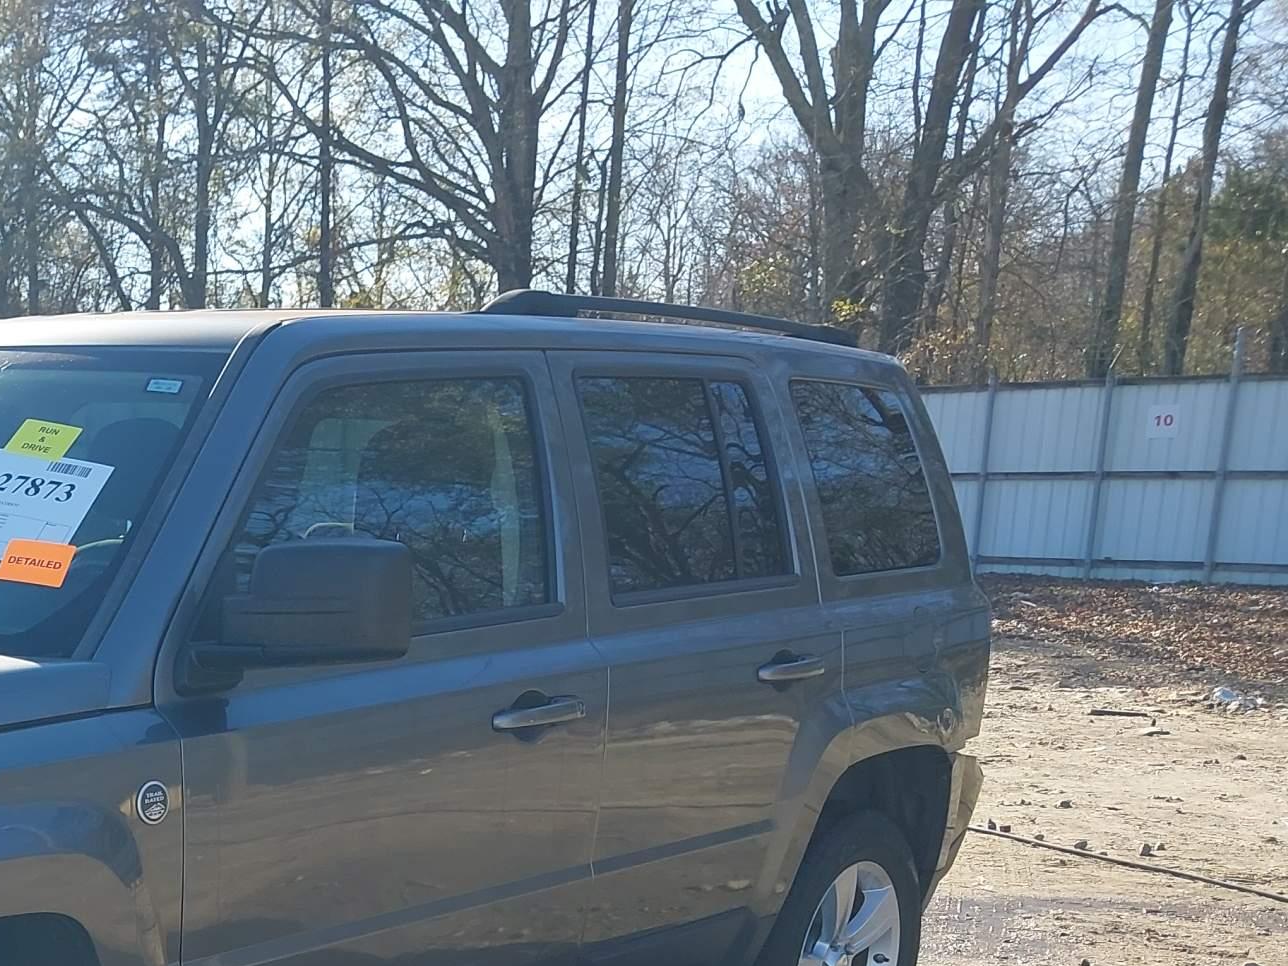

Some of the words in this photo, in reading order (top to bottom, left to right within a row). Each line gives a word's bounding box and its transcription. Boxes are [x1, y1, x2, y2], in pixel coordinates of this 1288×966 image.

[1154, 414, 1174, 427] 10
[38, 426, 60, 436] RUN
[21, 442, 52, 454] DRIVE
[7, 555, 62, 570] DETAILED
